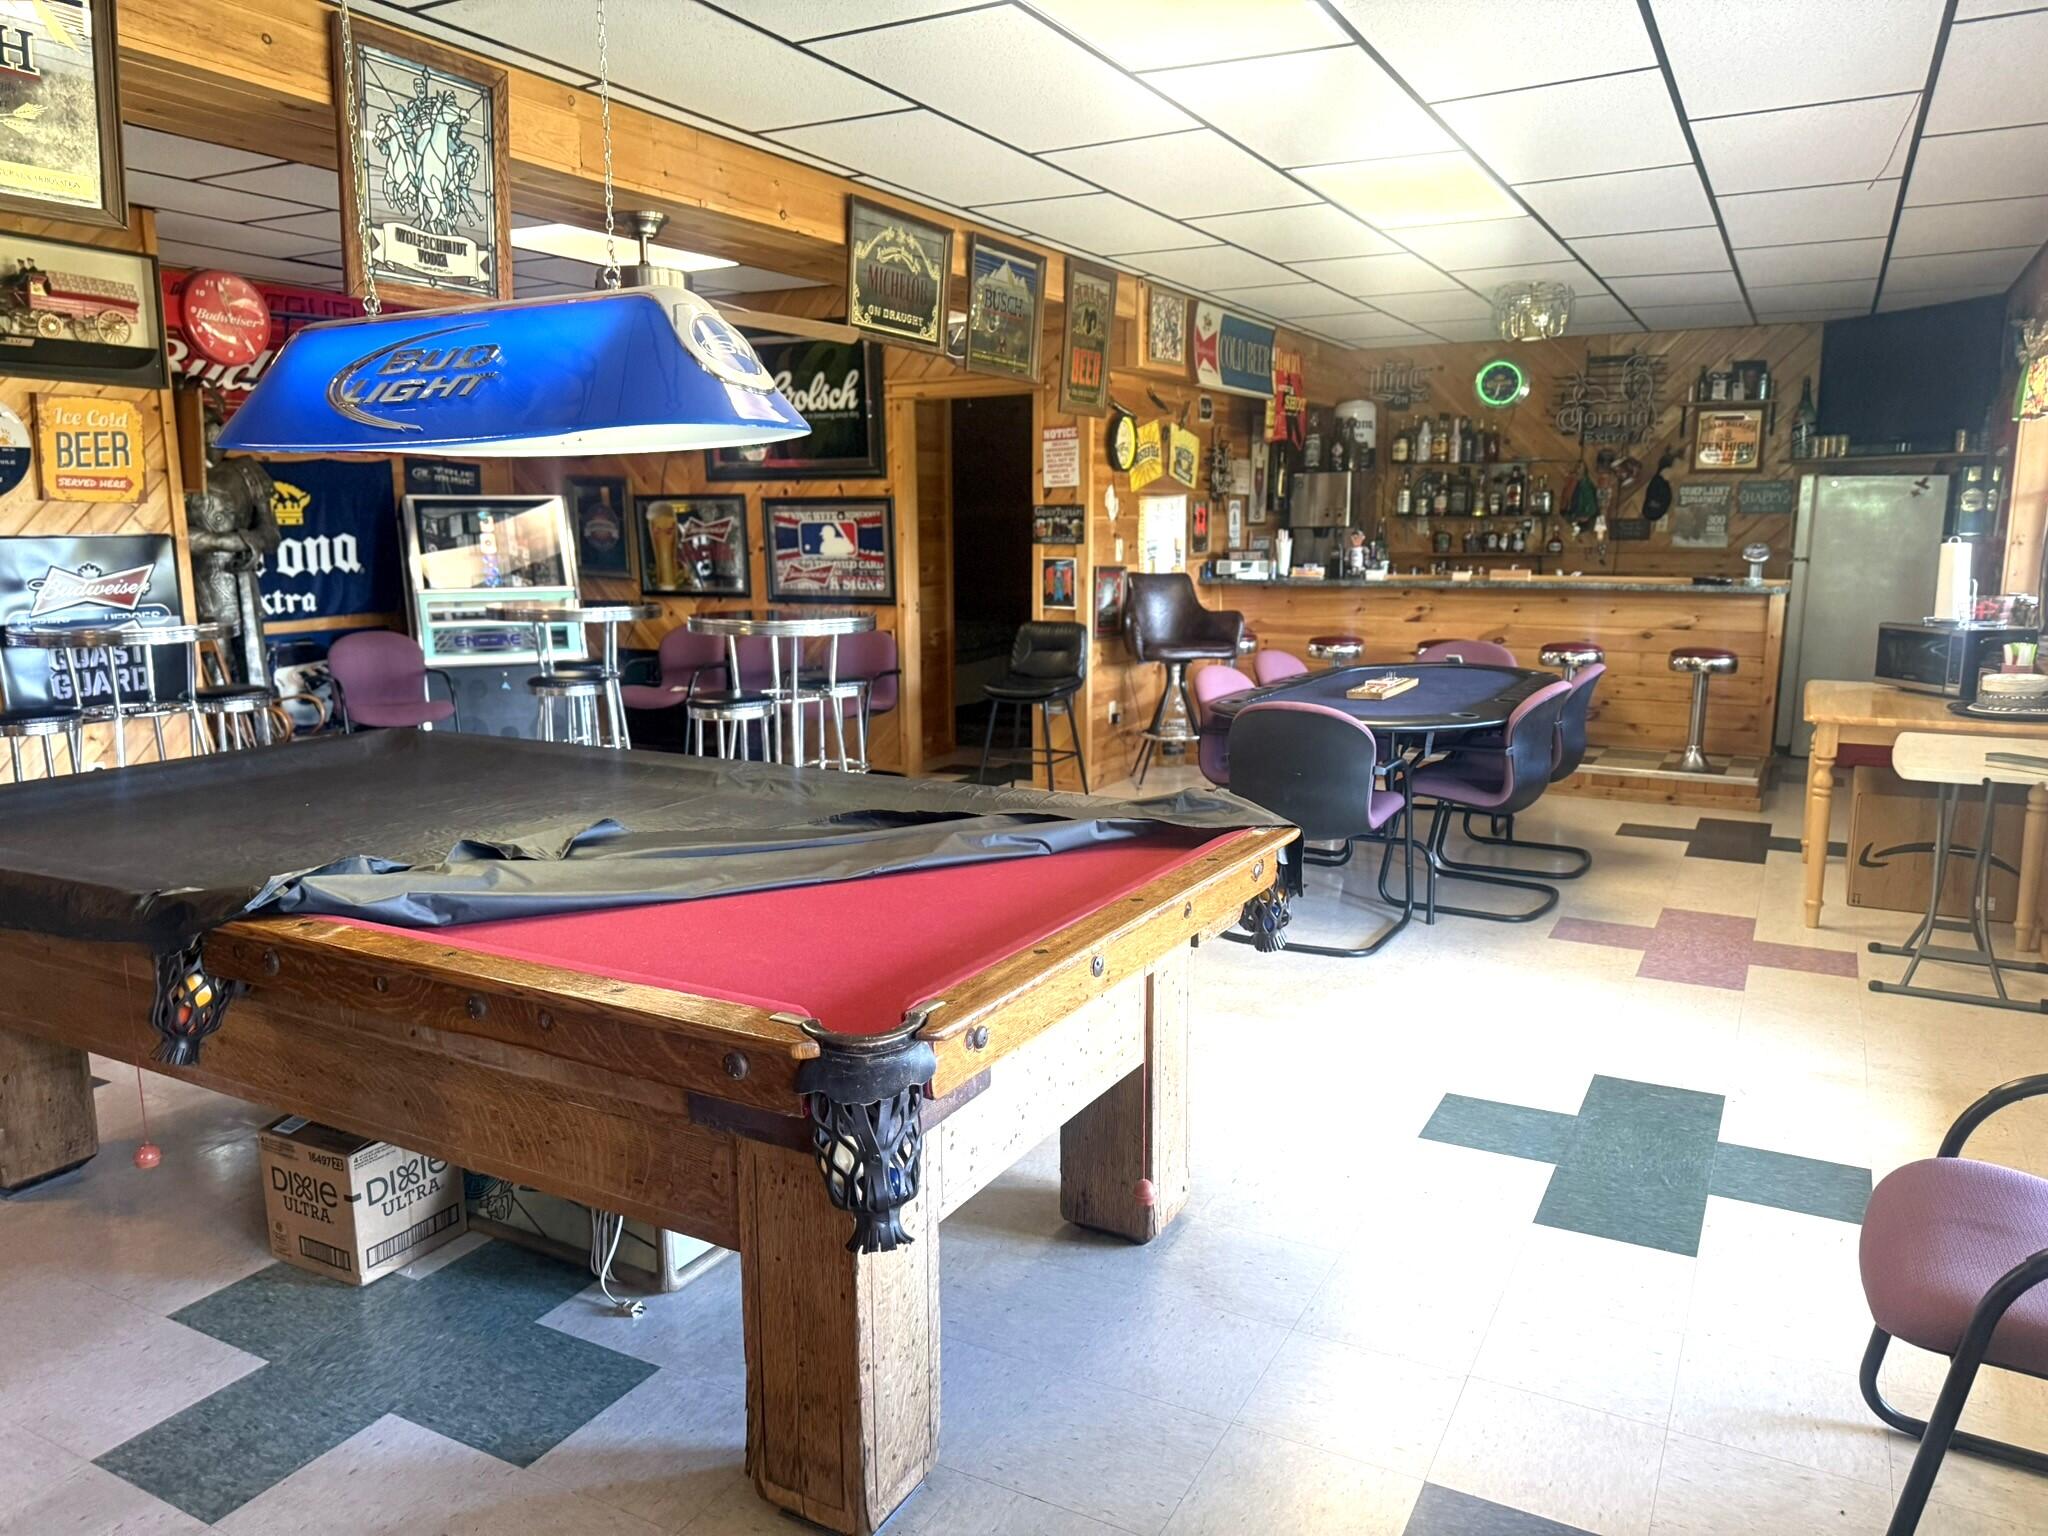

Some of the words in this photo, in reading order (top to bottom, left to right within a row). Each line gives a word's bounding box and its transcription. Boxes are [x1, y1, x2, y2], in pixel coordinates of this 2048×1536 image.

[395, 227, 468, 256] WOLFSCHMIDT
[418, 248, 449, 268] VODKA
[867, 304, 882, 317] ON
[882, 308, 925, 327] DRAUGHT
[984, 288, 1023, 318] BUSCH
[195, 307, 260, 329] Budweiser
[377, 344, 500, 374] BUD
[1220, 335, 1246, 371] COLD
[1247, 341, 1271, 378] BEER
[343, 372, 500, 404] LIGHT
[53, 407, 82, 426] Ice
[87, 408, 128, 428] Cold
[56, 431, 131, 468] BEER
[58, 477, 96, 488] SERVED
[99, 479, 127, 489] HERE
[33, 578, 150, 601] Budweiser
[261, 590, 317, 615] xtra
[283, 1195, 331, 1224] ULTRA
[381, 1177, 441, 1217] ULTRA
